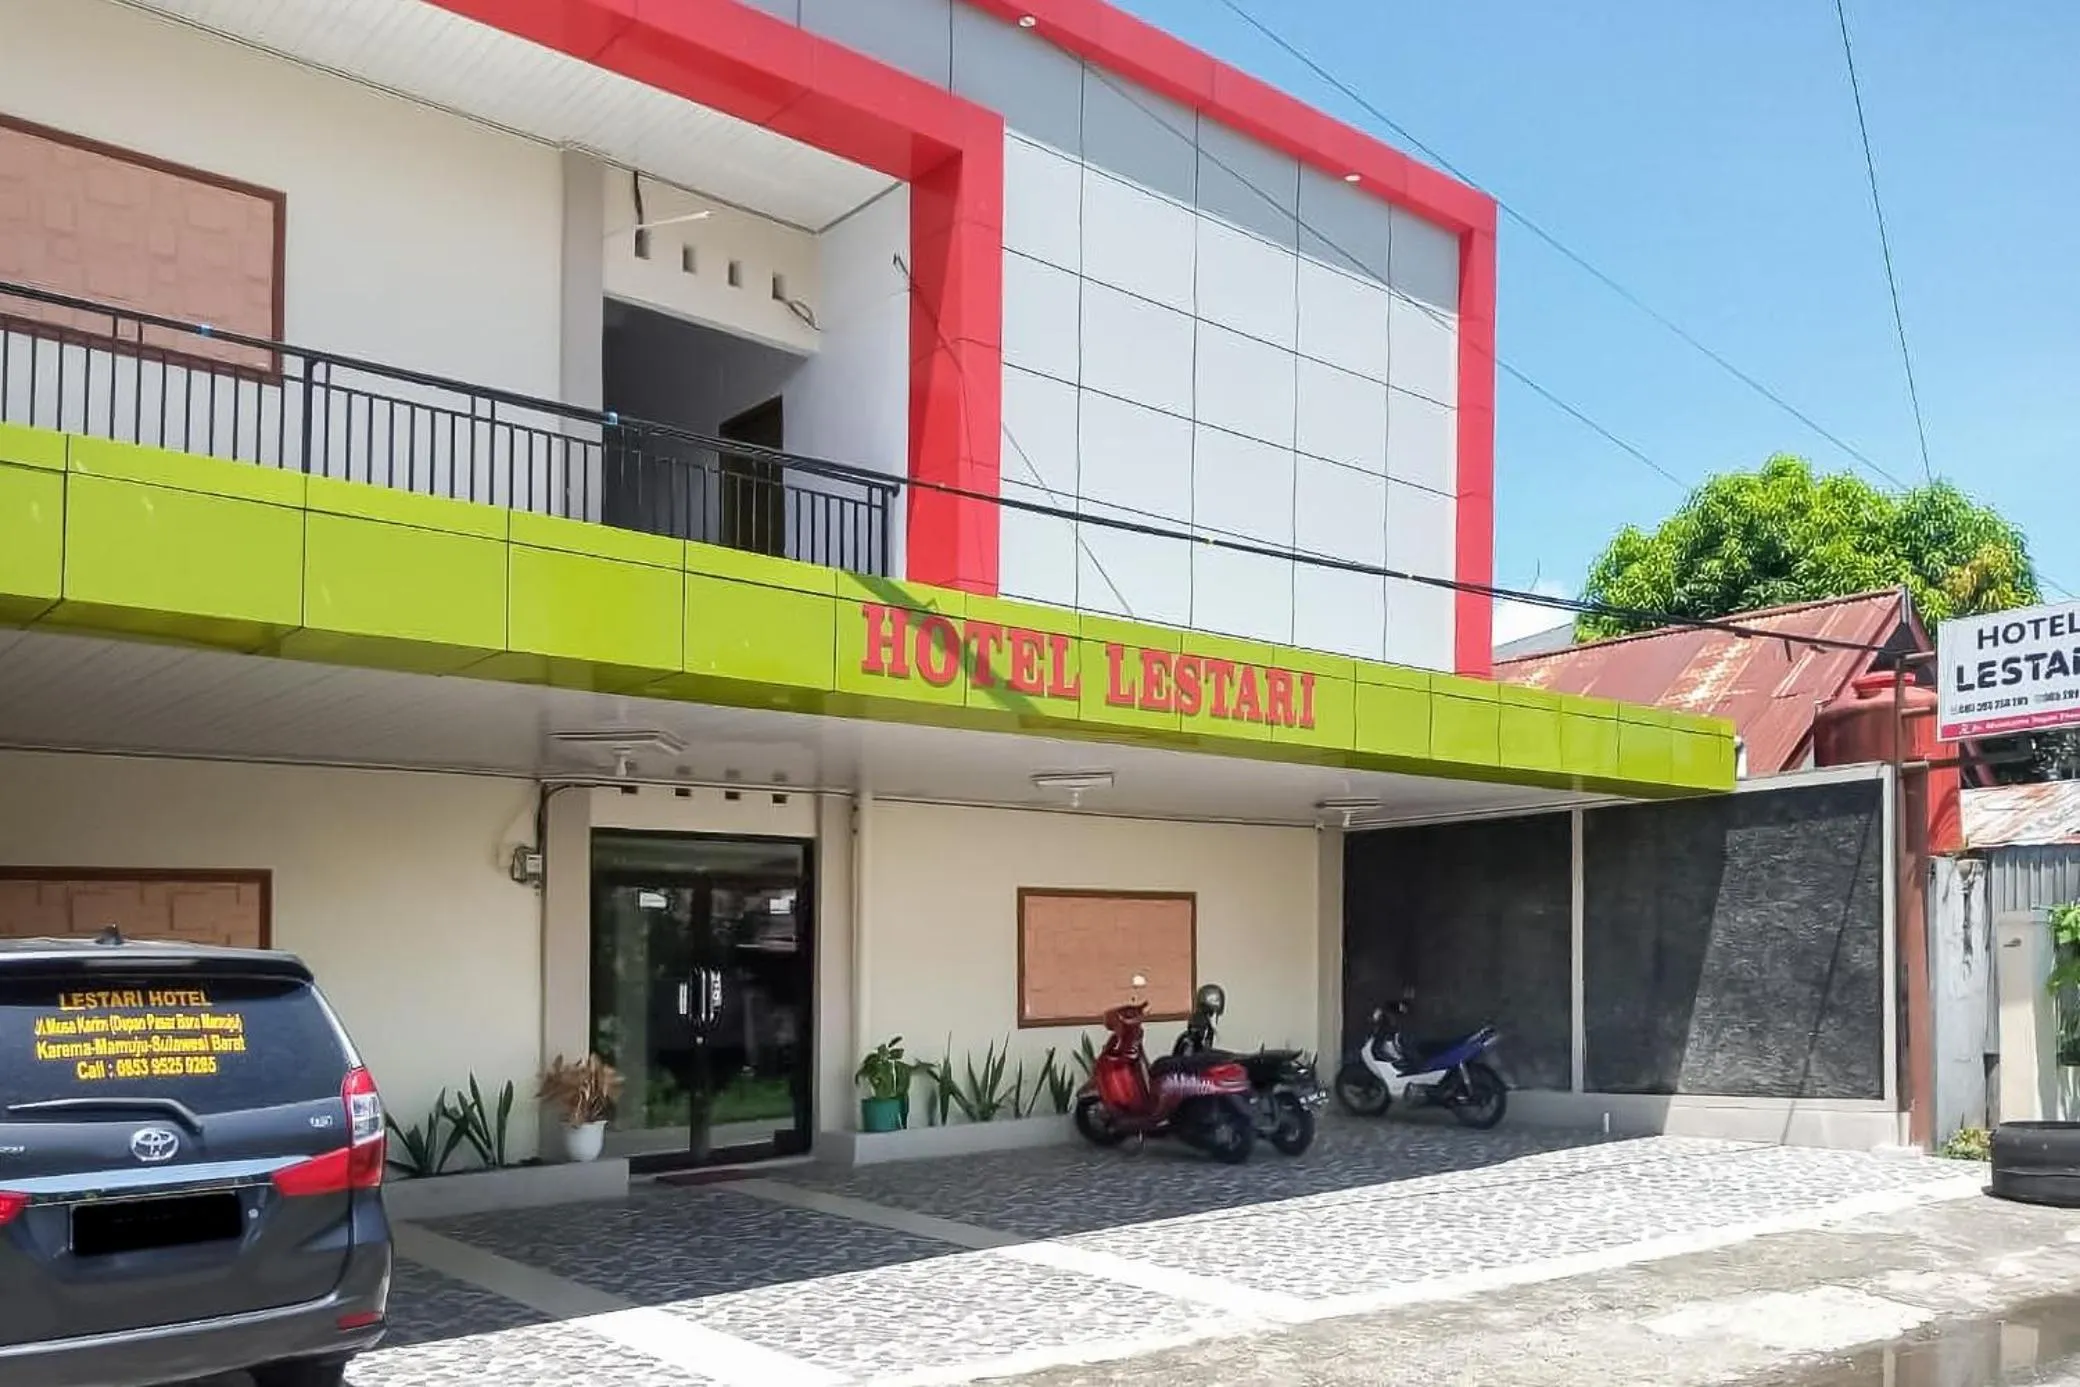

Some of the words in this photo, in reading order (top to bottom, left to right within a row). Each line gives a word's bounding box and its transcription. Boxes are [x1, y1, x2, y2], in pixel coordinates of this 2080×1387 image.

[1977, 612, 2080, 650] HOTEL
[861, 603, 1081, 700] HOTEL
[1106, 643, 1316, 729] LESTARI
[59, 990, 143, 1011] LESTARI
[148, 988, 213, 1007] HOTEL
[211, 1034, 246, 1051] Barat
[77, 1060, 105, 1079] Call
[116, 1057, 149, 1077] 0853
